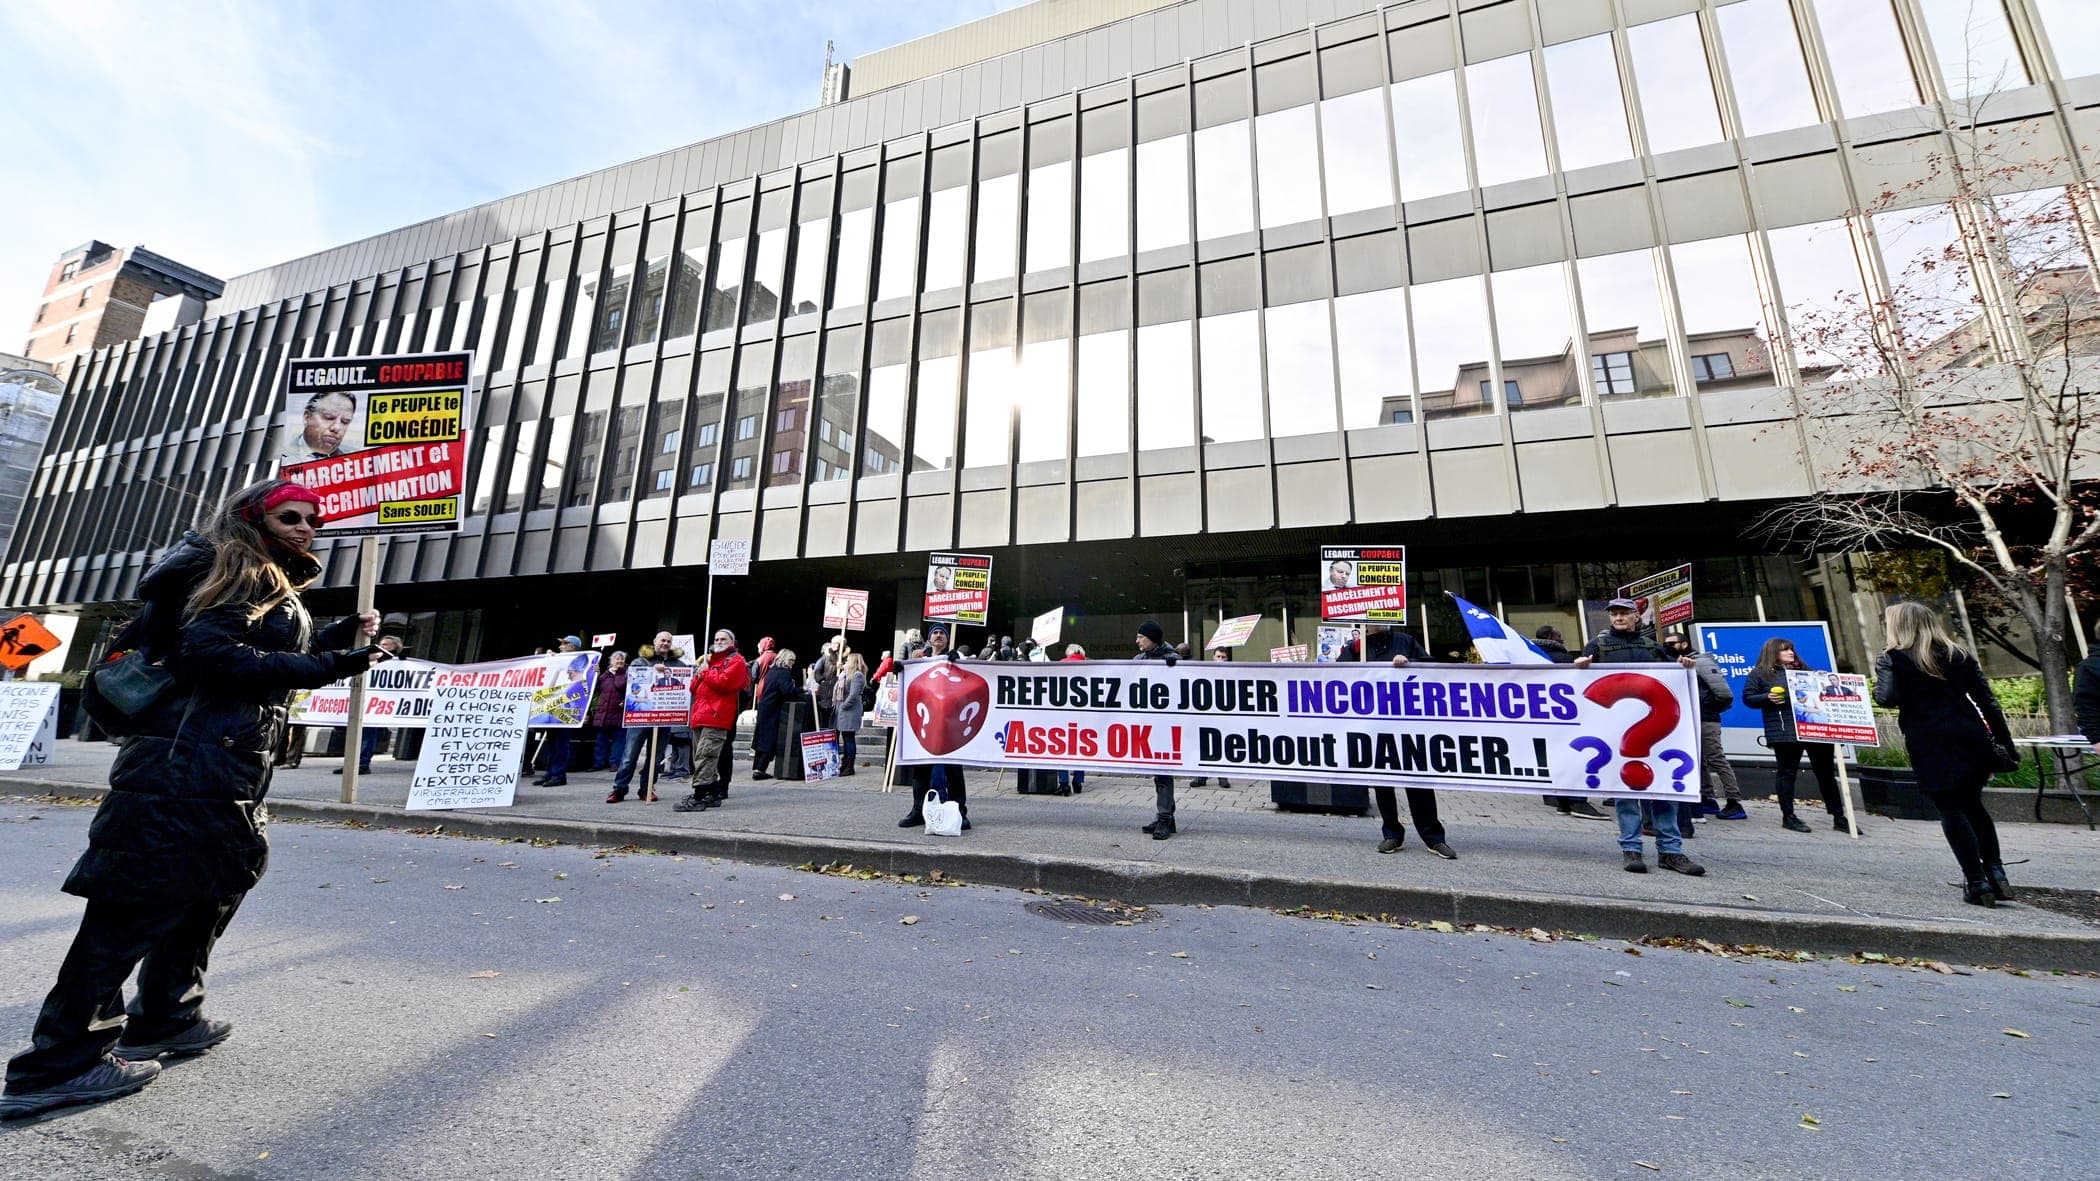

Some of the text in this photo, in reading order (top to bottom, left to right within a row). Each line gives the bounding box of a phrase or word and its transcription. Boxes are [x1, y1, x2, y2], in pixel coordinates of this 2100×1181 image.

[296, 362, 464, 386] LEGAULT... COUPABLE
[372, 397, 458, 414] Le PEUPLE te
[370, 416, 456, 440] CONGÉDIE
[429, 443, 450, 463] et
[318, 470, 452, 517] SCRIMINATION
[384, 503, 453, 518] Sans SOLDE !
[1361, 550, 1400, 558] COUPABLE
[1360, 574, 1400, 583] CONGÉDIE
[1328, 598, 1400, 615] DISCRIMINATION
[1707, 632, 1718, 649] 1
[369, 667, 436, 689] VOLONTÉ
[437, 672, 478, 687] c'est
[479, 674, 500, 687] un
[502, 667, 546, 687] CRIME
[437, 687, 477, 699] VOUS
[480, 689, 532, 700] OBLIGER
[997, 675, 1578, 720] REFUSEZ de JOUER INCOHÉRENCES
[10, 699, 40, 708] PAS
[365, 697, 394, 715] Pas
[396, 698, 411, 715] la
[445, 701, 454, 711] A
[460, 702, 517, 713] CHOISIR
[434, 714, 514, 725] ENTRE LES
[431, 727, 523, 738] INJECTIONS
[441, 742, 511, 751] ET VOTRE
[1005, 720, 1550, 777] Assis OK..! Debout DANGER..!
[440, 752, 502, 762] TRAVAIL
[436, 764, 498, 774] C'EST DE
[414, 774, 515, 788] L'EXTORSION
